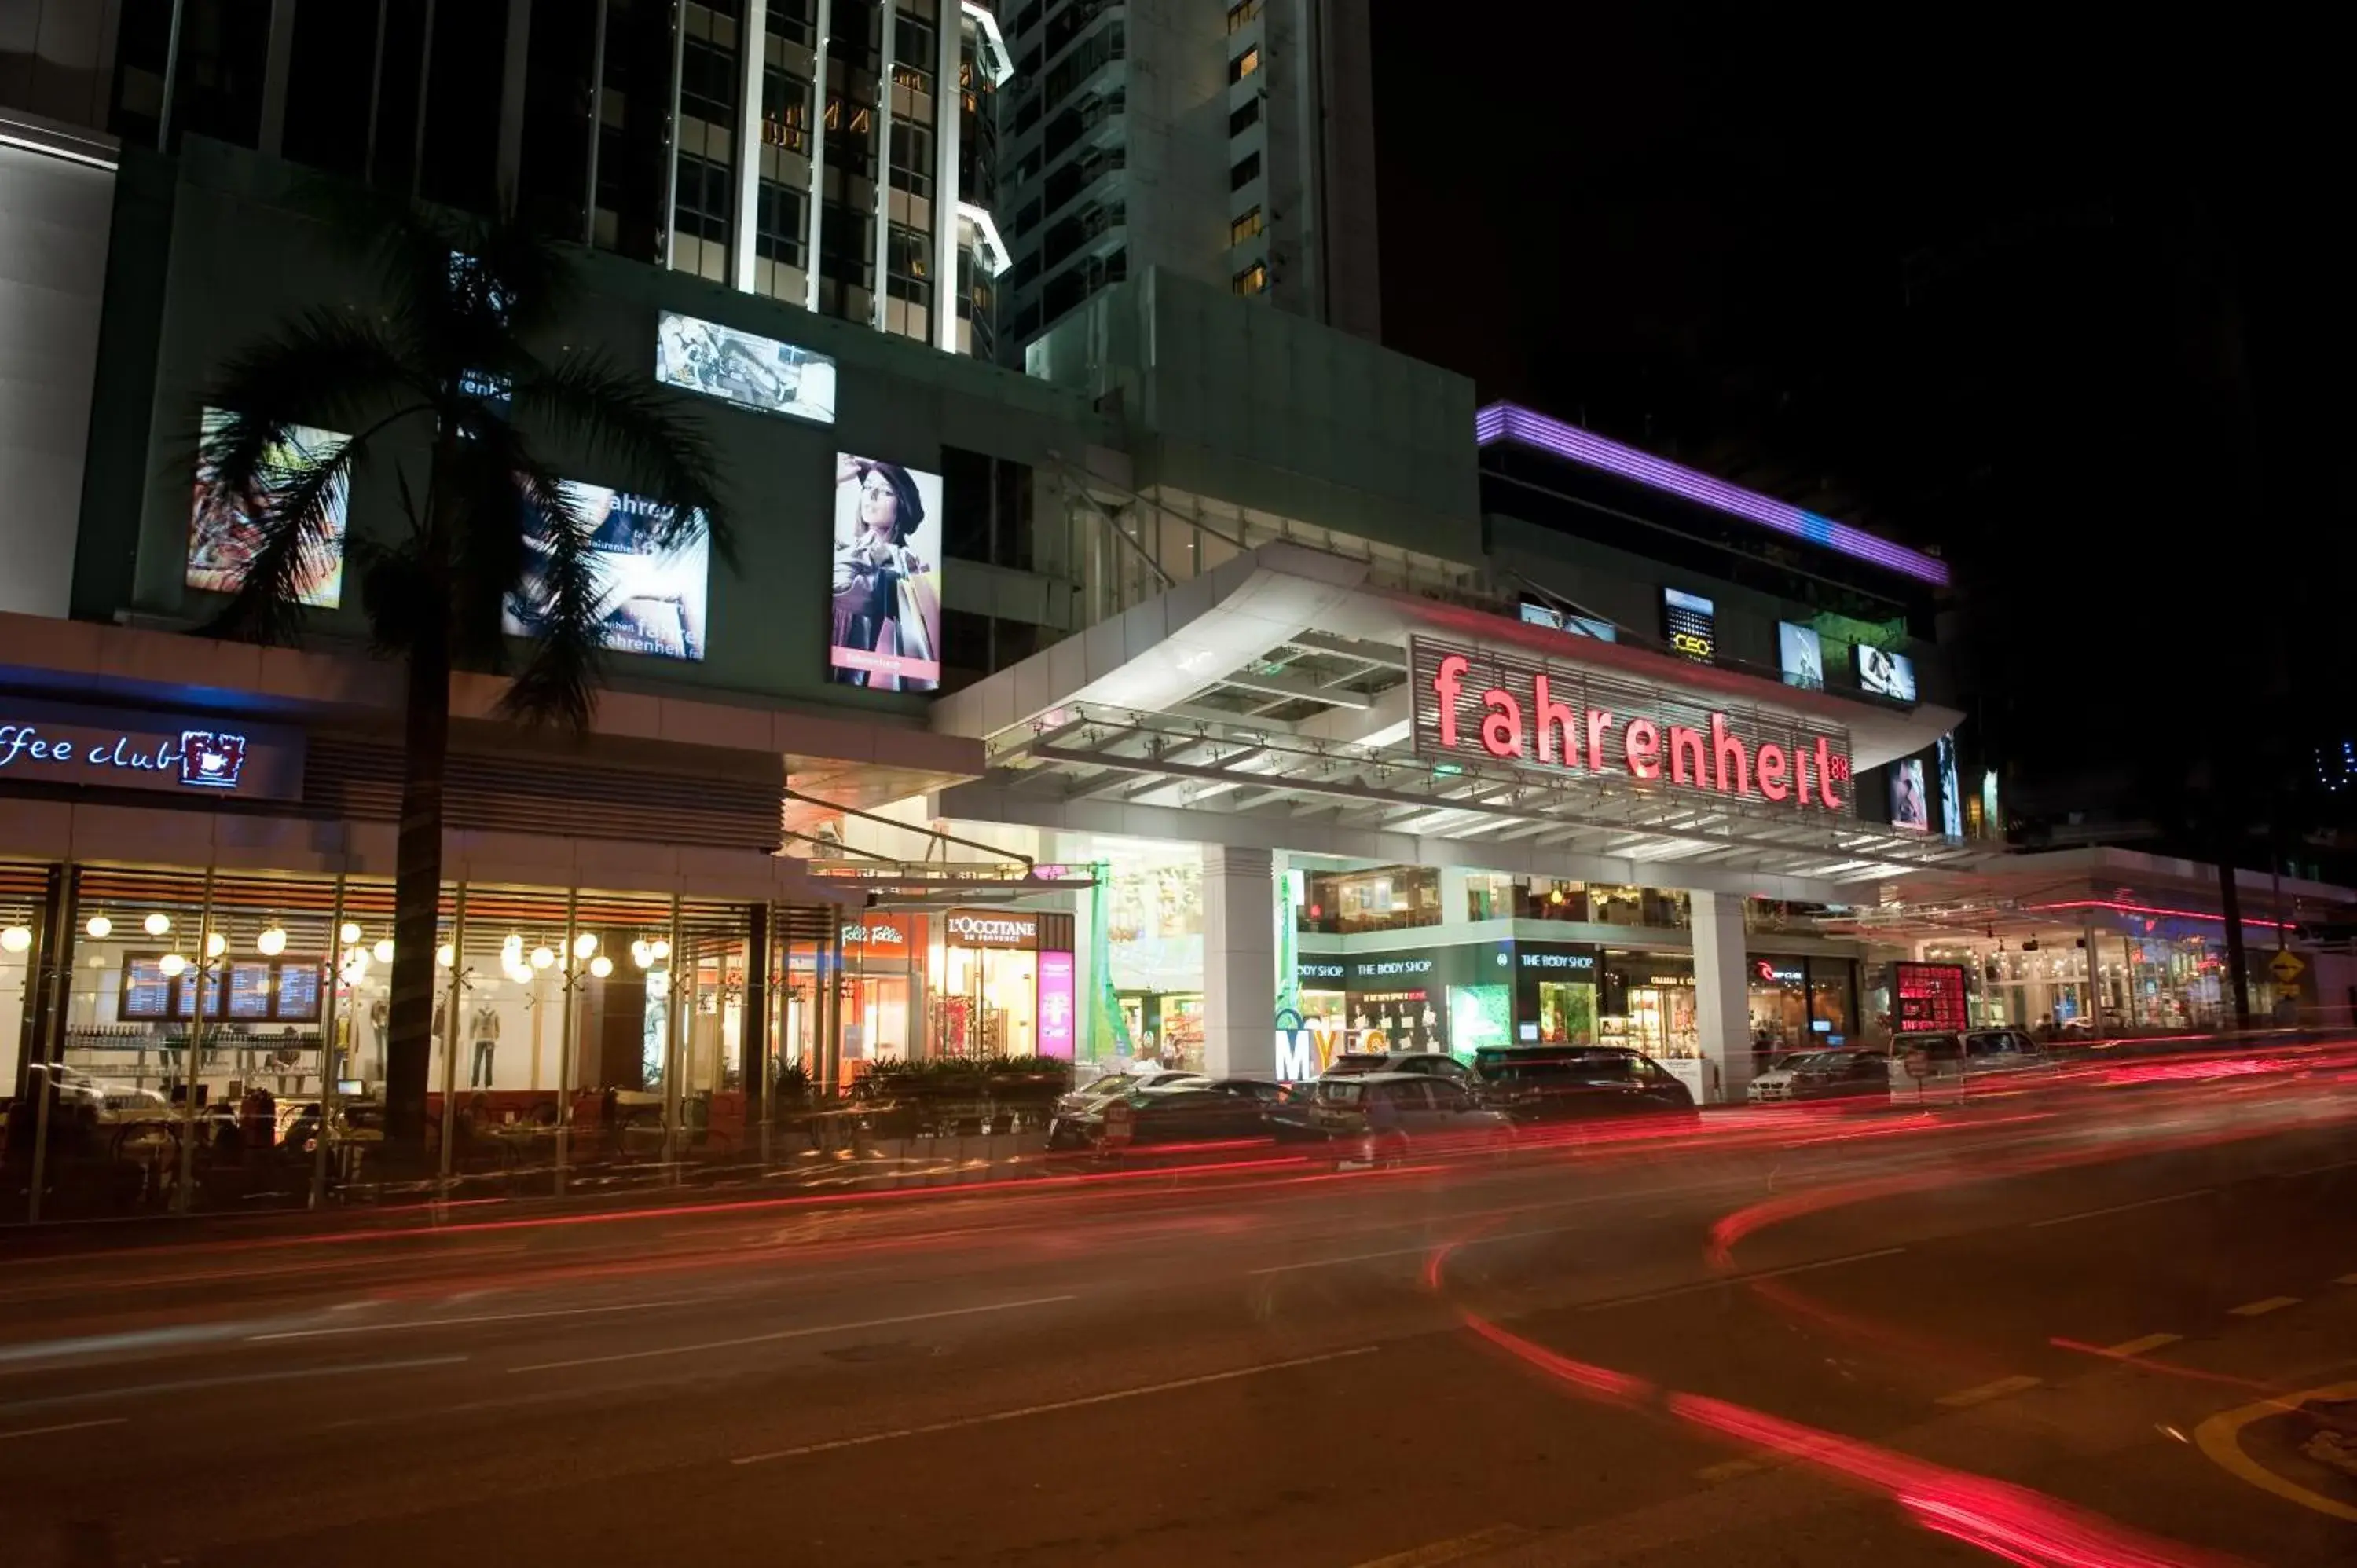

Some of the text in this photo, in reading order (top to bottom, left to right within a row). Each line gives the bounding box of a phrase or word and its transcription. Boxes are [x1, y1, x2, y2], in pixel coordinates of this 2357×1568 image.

[1434, 654, 1849, 809] fahrenheit 88
[88, 737, 183, 770] club
[948, 916, 1036, 936] L'OCCITANE
[1357, 964, 1375, 975] THE
[1377, 962, 1404, 974] BODY
[1520, 954, 1540, 967] THE
[1541, 954, 1567, 967] BODY
[1296, 965, 1316, 976] ODY
